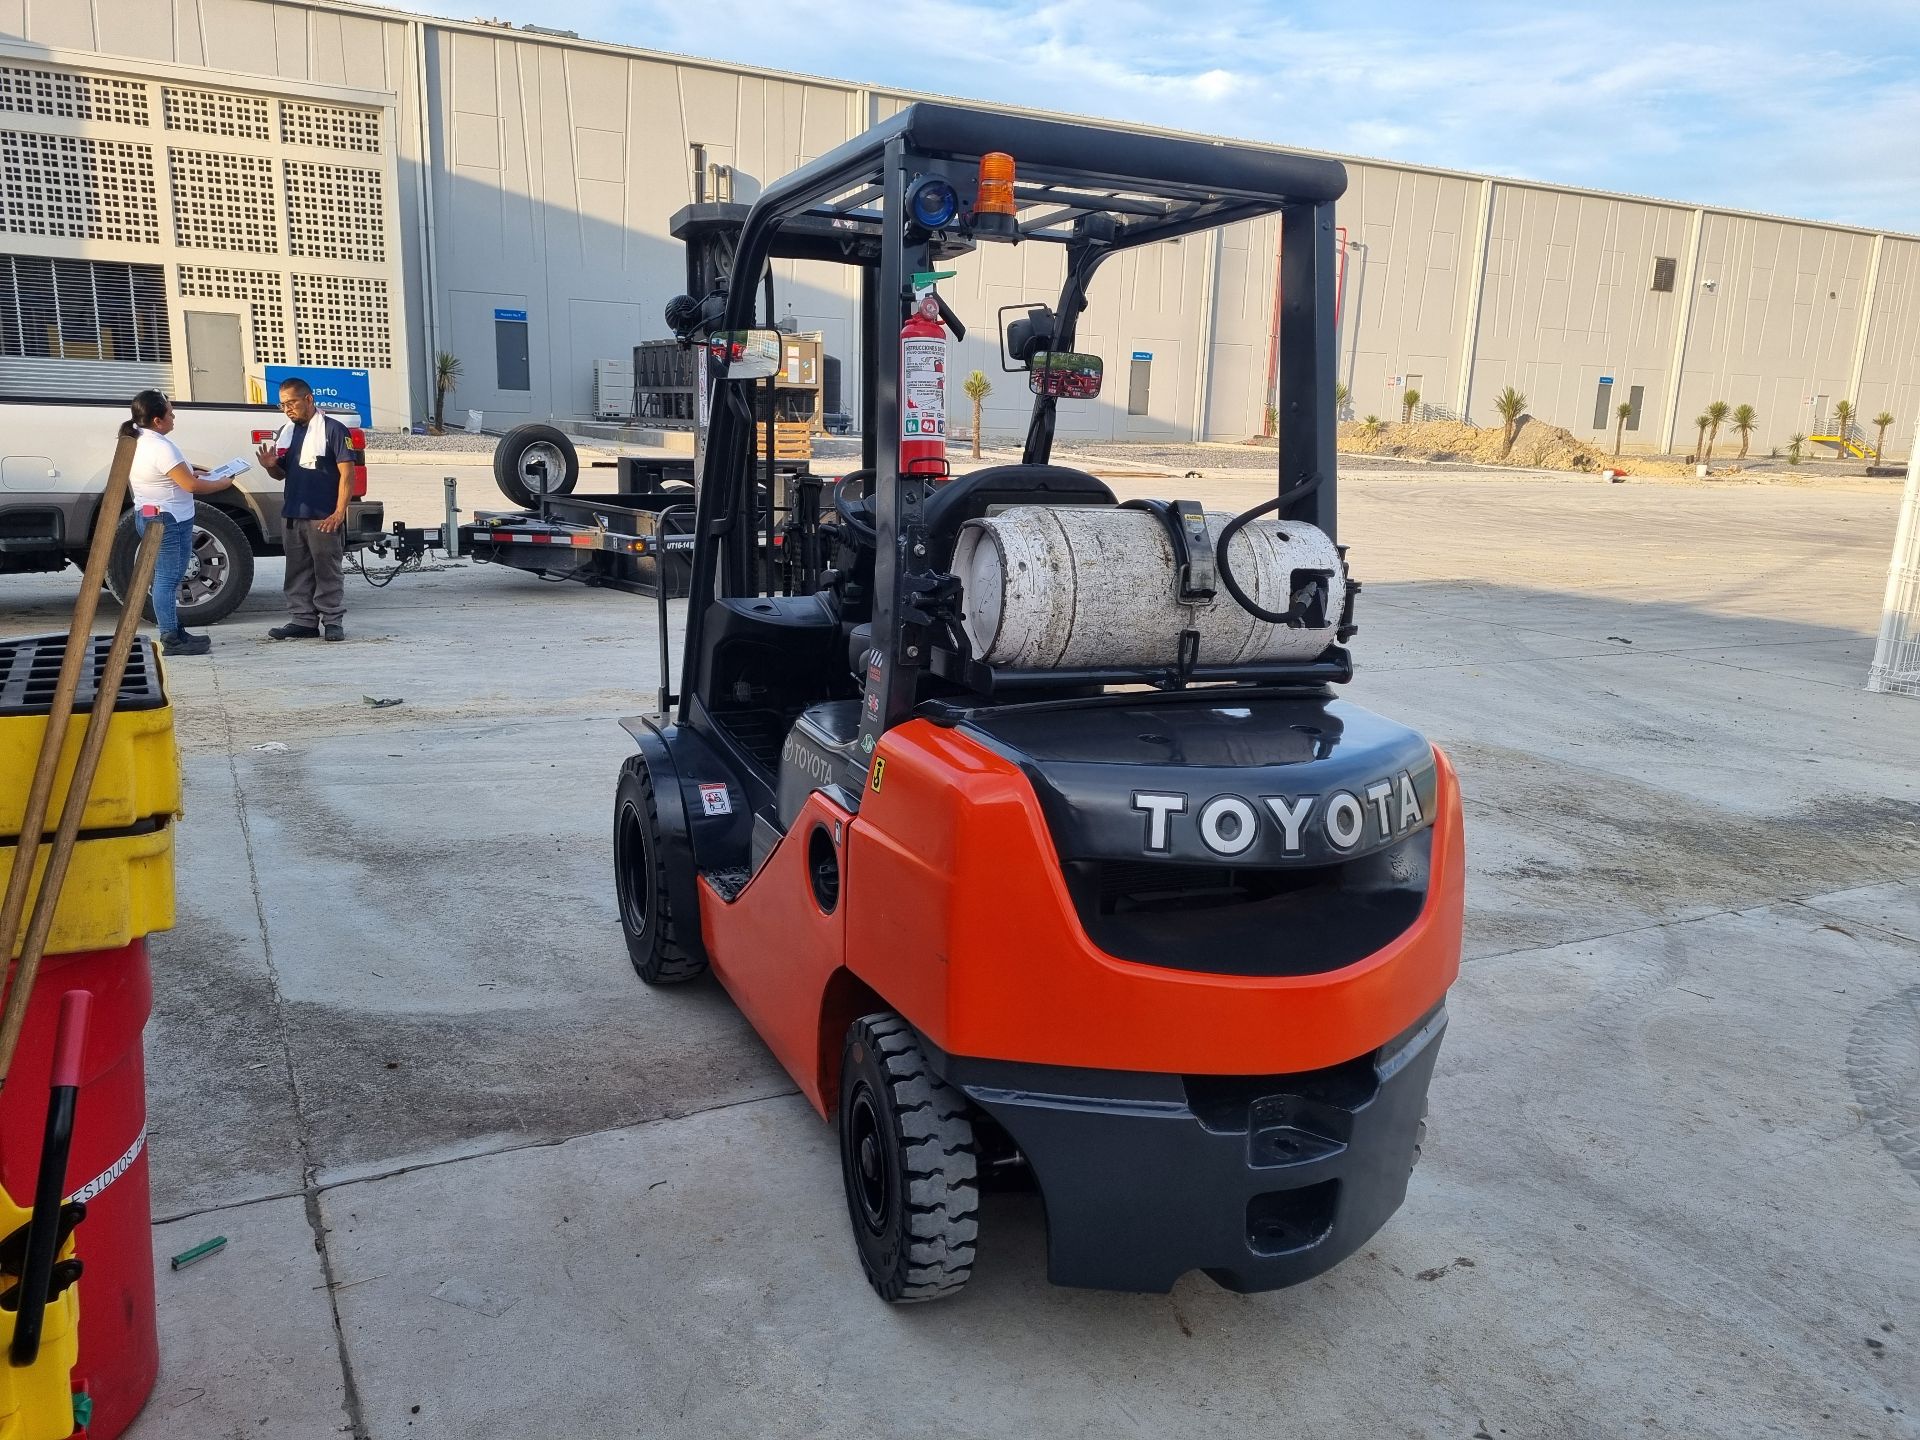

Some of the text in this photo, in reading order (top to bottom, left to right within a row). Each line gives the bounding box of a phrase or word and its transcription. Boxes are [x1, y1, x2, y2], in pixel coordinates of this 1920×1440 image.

[312, 387, 338, 396] uarto
[314, 402, 356, 410] resores
[794, 743, 833, 785] TOYOTA
[1133, 772, 1424, 856] TOYOTA
[71, 1150, 133, 1203] ESIDUOS
